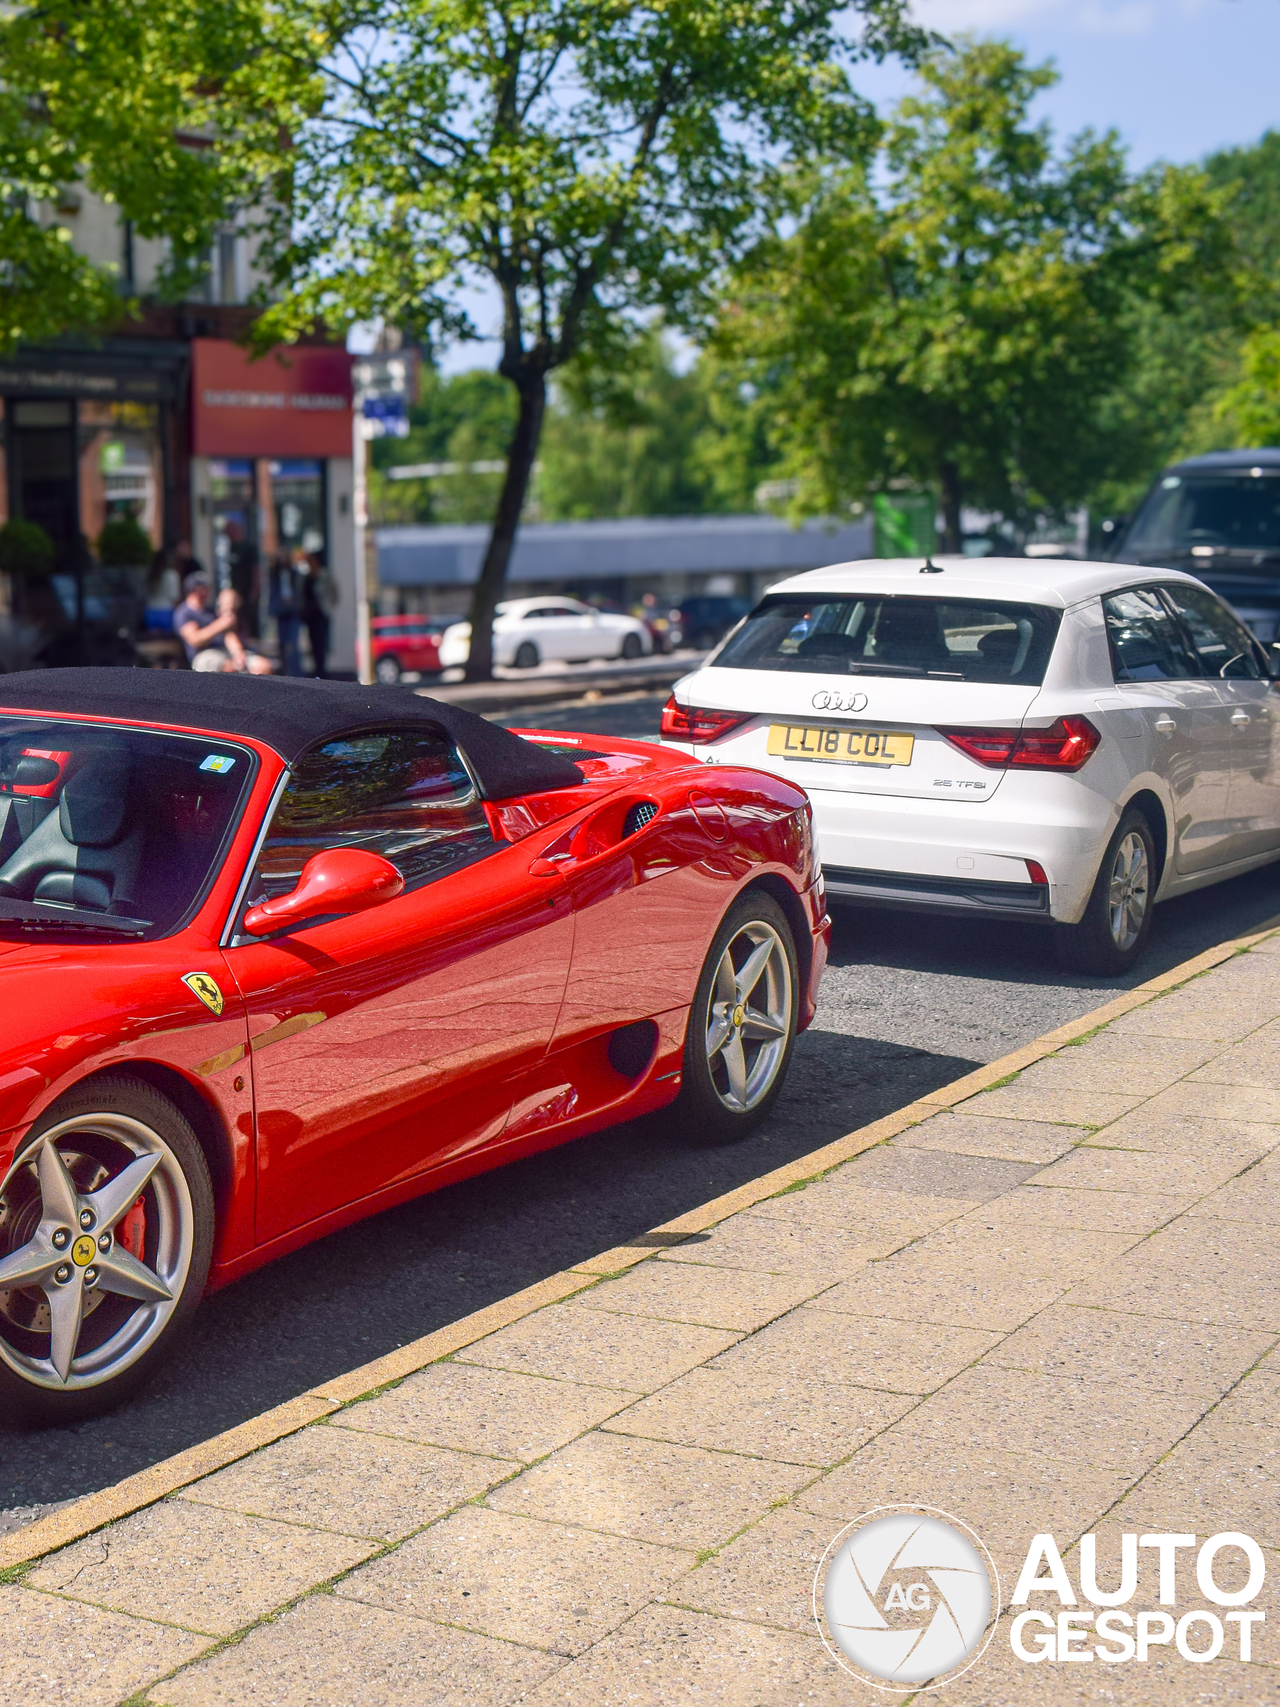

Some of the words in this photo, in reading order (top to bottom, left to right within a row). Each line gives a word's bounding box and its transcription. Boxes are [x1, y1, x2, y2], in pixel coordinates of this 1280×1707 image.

[784, 726, 840, 754] LL18
[847, 731, 895, 758] COL
[933, 779, 952, 788] 25
[956, 780, 987, 789] TFSI
